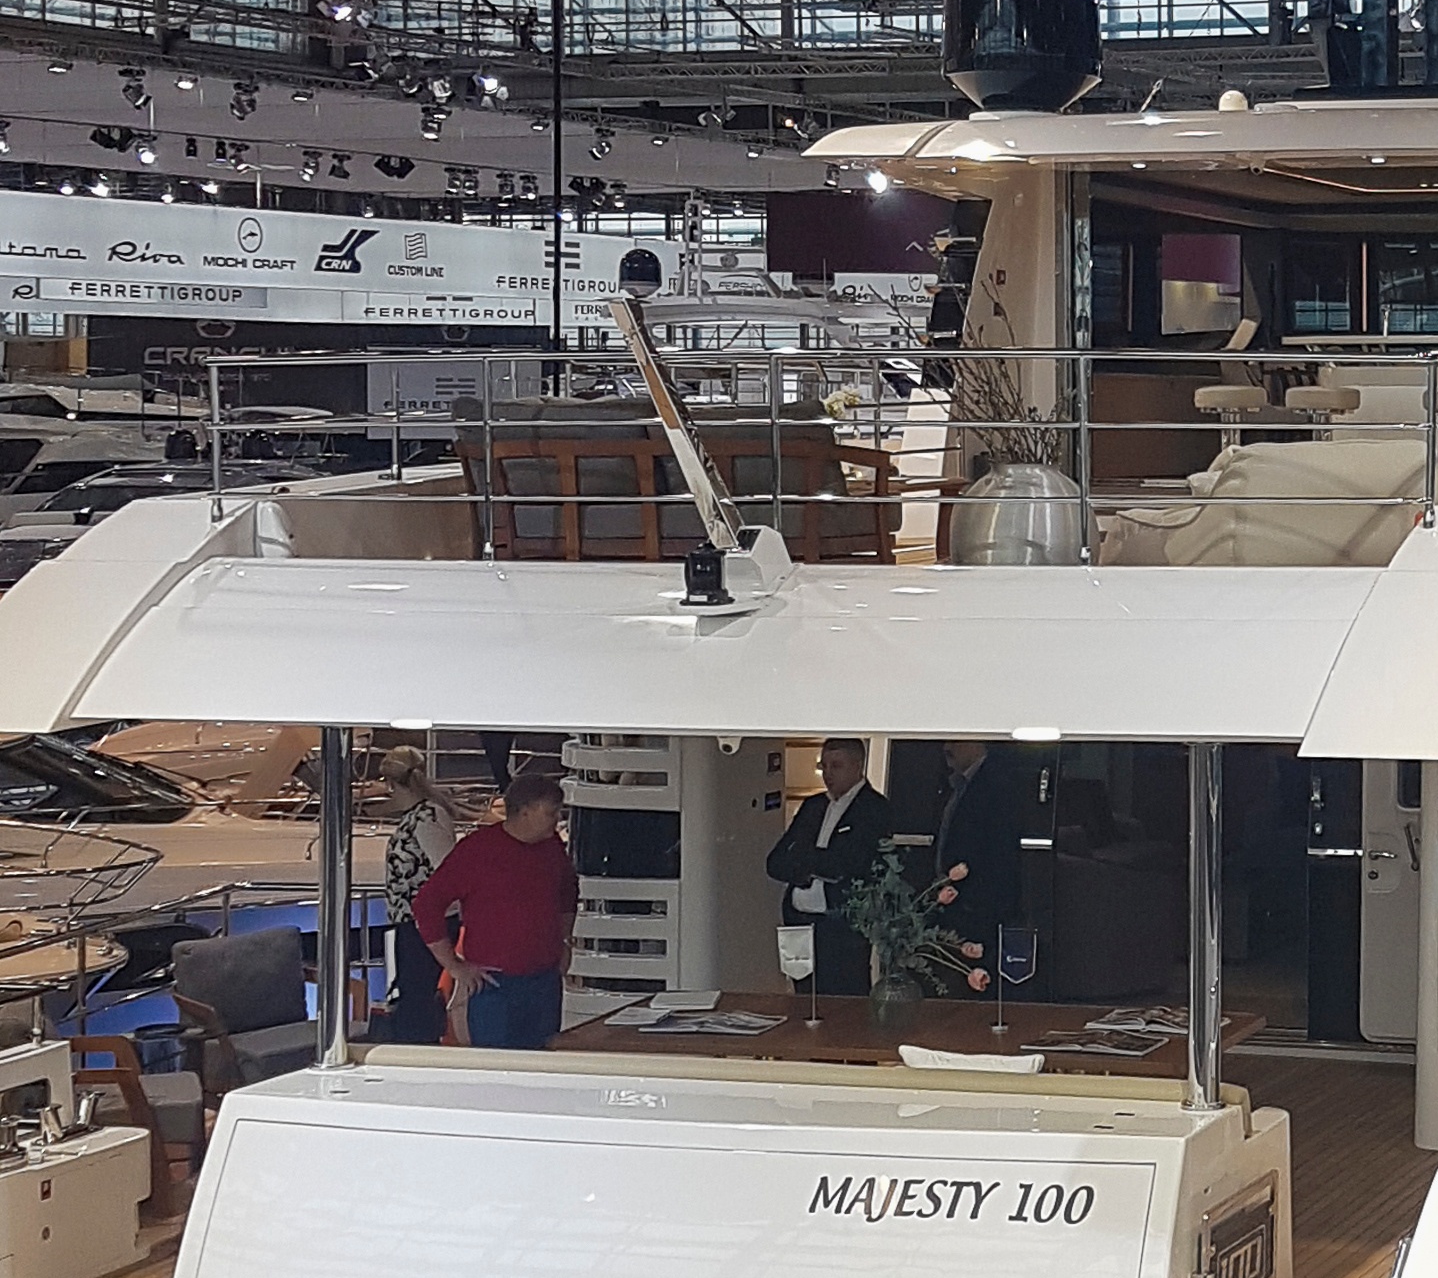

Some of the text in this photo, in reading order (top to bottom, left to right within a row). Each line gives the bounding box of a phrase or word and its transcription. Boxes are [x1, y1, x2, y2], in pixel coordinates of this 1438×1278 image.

[107, 240, 186, 266] Riva
[202, 255, 297, 271] MOCHI CRAFT
[320, 258, 353, 271] CRN
[387, 264, 445, 279] CUSTOM LINE
[68, 281, 243, 303] FERRETTIGROUP
[495, 275, 622, 295] FERRETIGROU
[808, 1175, 1096, 1225] MAJESTY 100
